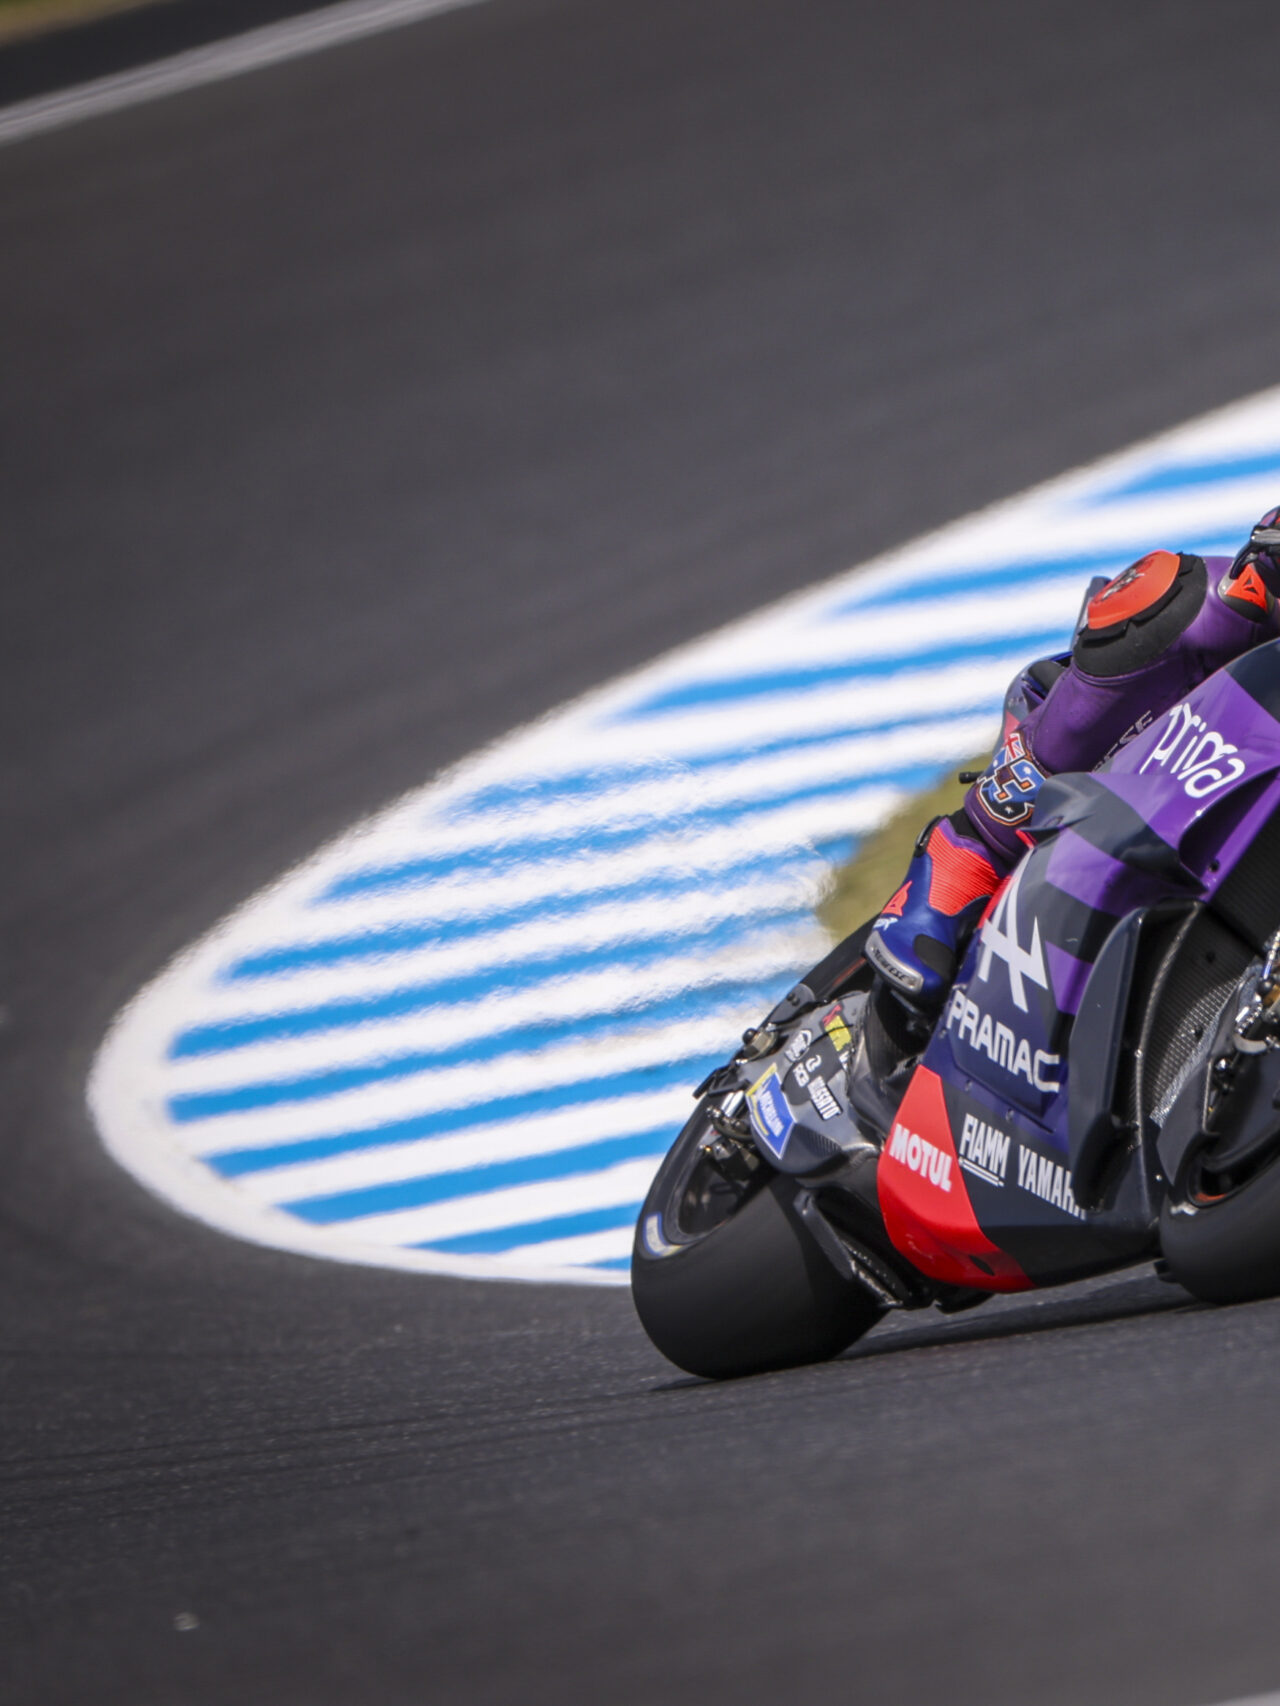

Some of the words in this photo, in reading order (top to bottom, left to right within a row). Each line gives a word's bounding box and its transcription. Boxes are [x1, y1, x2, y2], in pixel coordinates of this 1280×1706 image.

[1138, 702, 1246, 798] prima
[946, 990, 1060, 1093] PRAMAC
[888, 1123, 953, 1193] MOTUL
[959, 1112, 1011, 1179] FIAMM
